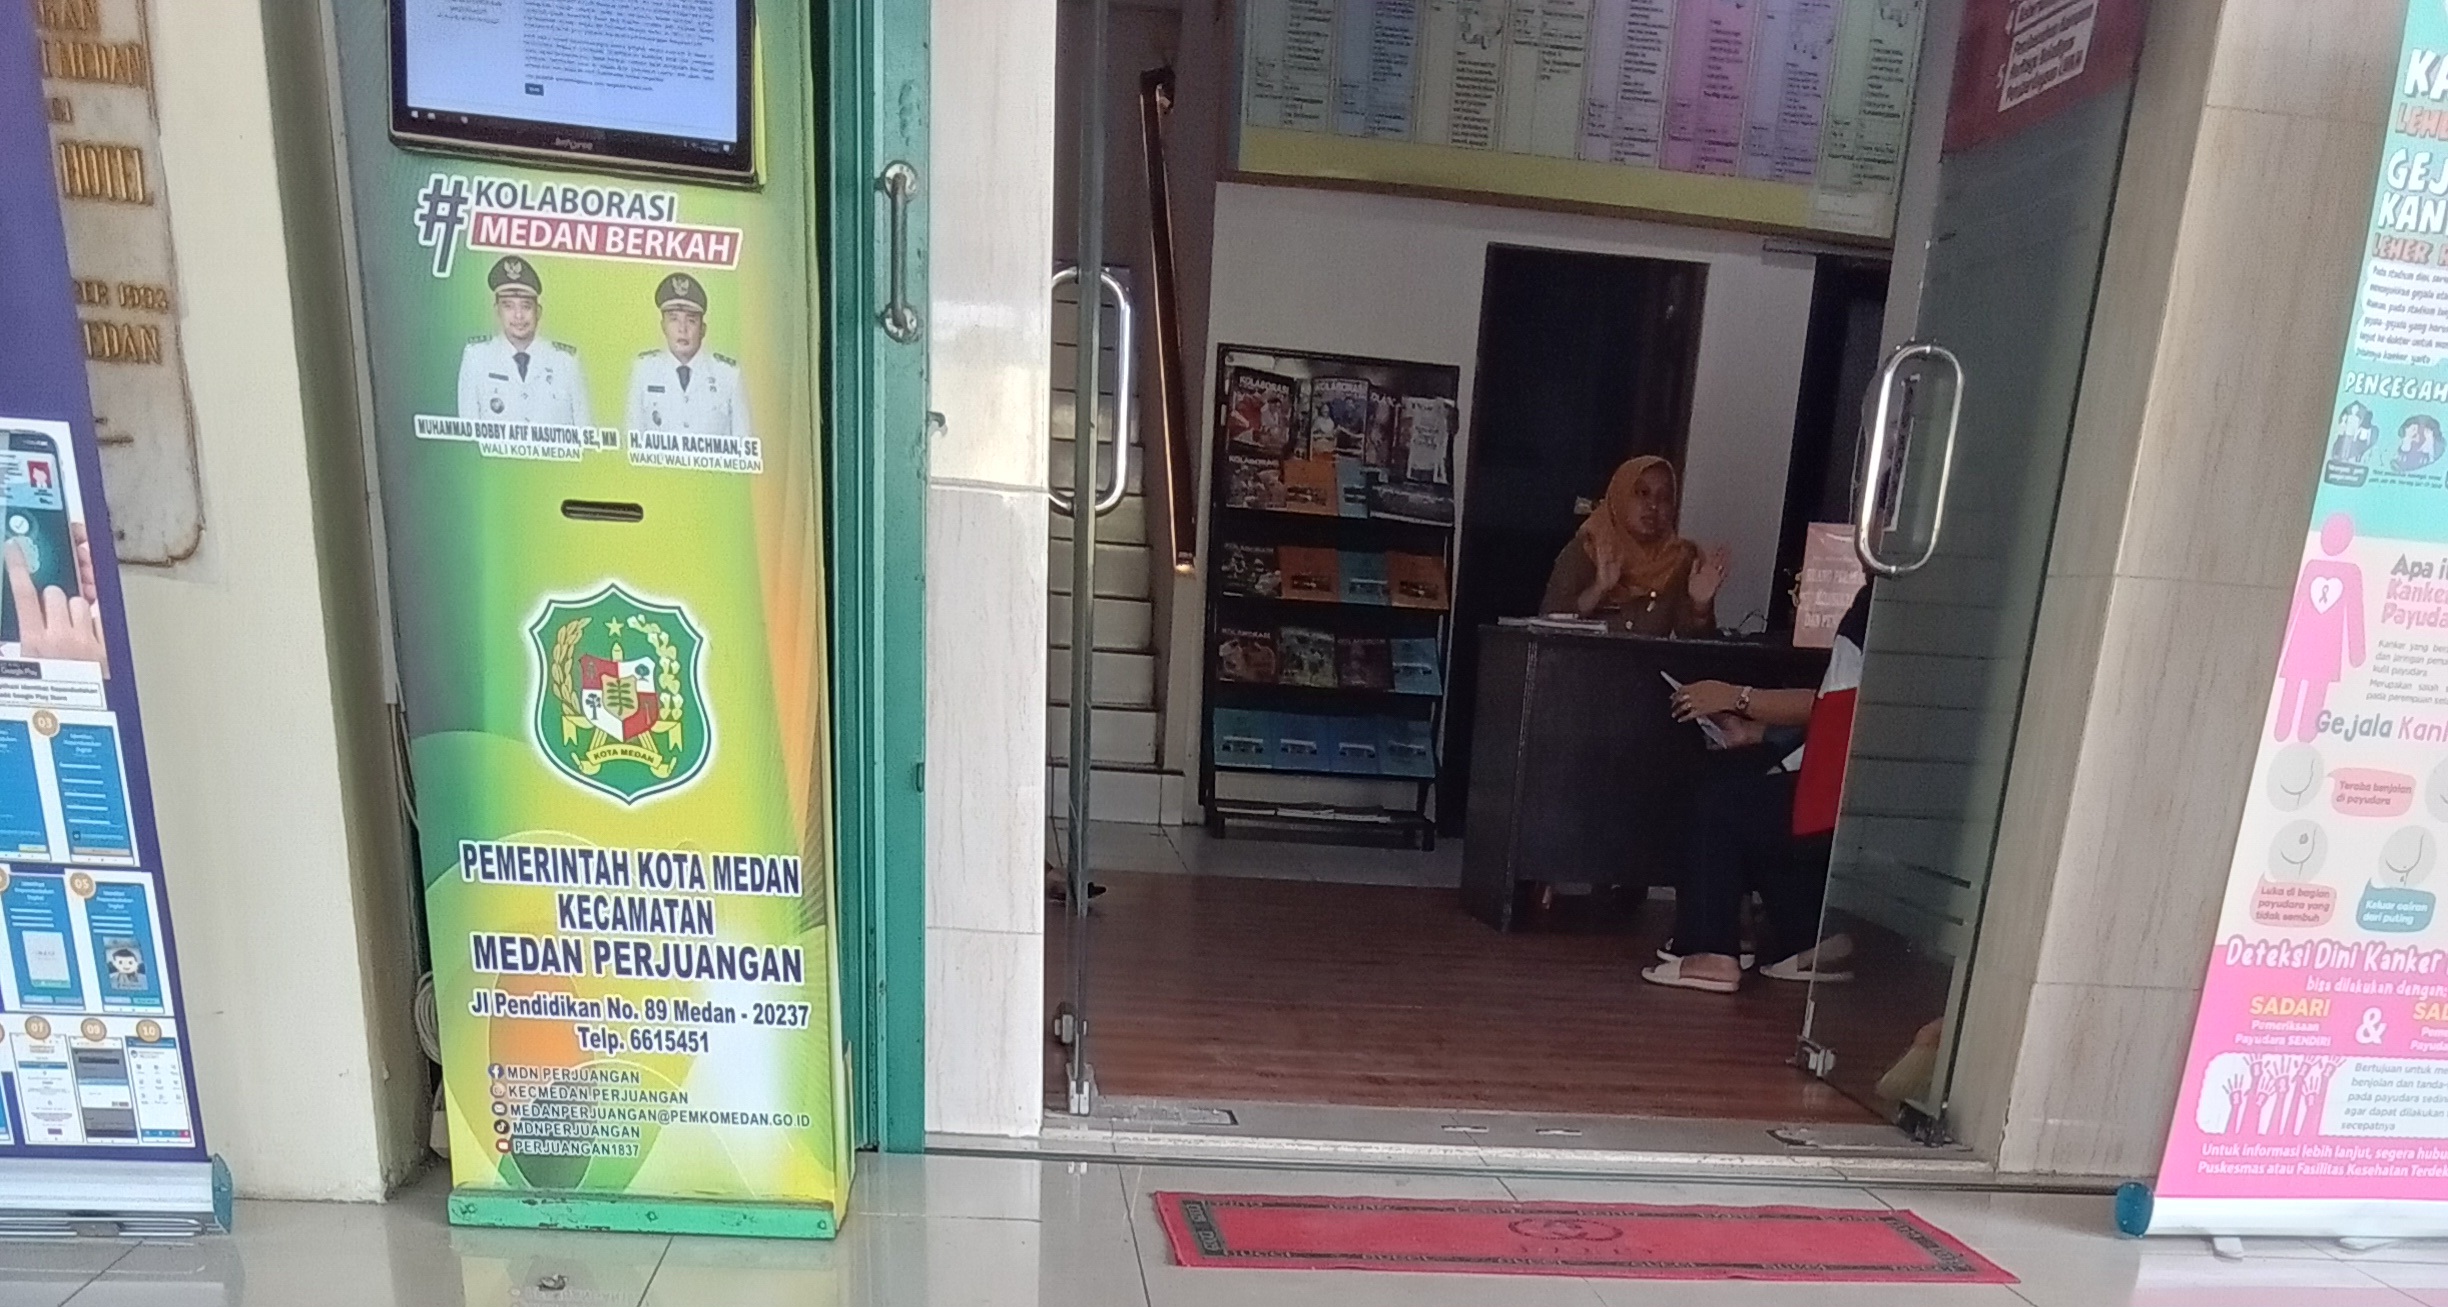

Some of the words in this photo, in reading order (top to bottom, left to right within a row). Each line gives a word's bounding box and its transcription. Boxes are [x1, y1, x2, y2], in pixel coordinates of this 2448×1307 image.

[59, 140, 152, 206] HOTEL
[475, 180, 676, 222] KOLABORASI
[2378, 191, 2448, 235] KAN
[480, 217, 598, 253] MEDAN
[605, 228, 731, 263] BERKAH
[2372, 232, 2433, 265] LEHER
[82, 320, 162, 364] EDAN
[418, 418, 472, 438] MUHAMMAD
[475, 422, 507, 440] BOBBY
[509, 425, 529, 441] AFIF
[531, 426, 581, 445] NASUTION,
[602, 431, 617, 446] MM
[482, 443, 507, 454] WALI
[511, 445, 539, 457] KOTA
[541, 446, 580, 459] MEDAN
[630, 432, 642, 448] H.
[645, 433, 679, 451] AULIA
[682, 436, 742, 456] RACHMAN,
[744, 440, 759, 456] SE
[630, 453, 659, 464] WAKIL
[665, 454, 690, 466] WALI
[692, 456, 720, 468] KOTA
[723, 458, 761, 471] MEDAN
[2390, 553, 2434, 582] Apa
[2409, 643, 2429, 653] yang
[2365, 692, 2387, 701] pada
[2316, 709, 2394, 742] Gejala
[593, 748, 618, 760] KOTA
[620, 748, 655, 763] MEDAN
[2340, 780, 2371, 791] Teraba
[2373, 783, 2412, 795] benjolan
[2336, 793, 2346, 802] di
[2346, 795, 2391, 805] payudara
[463, 844, 630, 886] PEMERINTAH
[638, 851, 706, 890] KOTA
[713, 855, 800, 894] MEDAN
[74, 878, 89, 889] 05
[2261, 886, 2284, 897] Luka
[2286, 887, 2296, 897] di
[2299, 887, 2330, 900] bagian
[2257, 900, 2305, 911] payudara
[2307, 902, 2331, 913] yang
[2365, 899, 2395, 911] Keluar
[559, 893, 714, 935] KECAMATAN
[2255, 911, 2280, 921] tidak
[2282, 912, 2320, 923] sembuh
[2362, 912, 2382, 923] dari
[2383, 913, 2415, 926] puting
[473, 935, 583, 974] MEDAN
[593, 941, 803, 983] PERJUANGAN
[2226, 936, 2313, 969] Deteksi
[2314, 940, 2359, 970] Dini
[2364, 943, 2443, 975] Kanker
[2306, 974, 2332, 993] bisa
[2333, 976, 2394, 996] dilakukan
[496, 993, 601, 1019] Pendidikan
[608, 998, 639, 1020] No.
[645, 999, 668, 1022] 89
[675, 1001, 736, 1024] Medan
[754, 1003, 810, 1027] 20237
[2249, 996, 2331, 1017] SADARI
[2356, 1006, 2387, 1045] &
[2250, 1019, 2320, 1033] Pemeriksaan
[142, 1026, 156, 1035] 10
[577, 1026, 625, 1053] Telp.
[631, 1029, 710, 1053] 6615451
[2234, 1033, 2286, 1047] Payudara
[2287, 1035, 2332, 1047] SENDIRI
[508, 1067, 539, 1080] MDN
[543, 1068, 640, 1084] PERJUANGAN
[2354, 1062, 2403, 1074] Bertujuan
[2405, 1064, 2431, 1074] untuk
[2351, 1077, 2394, 1088] benjolan
[2396, 1079, 2414, 1088] dan
[2347, 1092, 2373, 1102] pada
[2374, 1093, 2420, 1103] payudara
[2344, 1107, 2367, 1117] agar
[2368, 1107, 2397, 1117] dapat
[2399, 1108, 2445, 1118] dilakukan
[513, 1122, 641, 1139] MDNPERJUANGAN
[2341, 1122, 2396, 1132] secepatnya
[515, 1140, 640, 1157] PERJUANGAN1837
[2202, 1143, 2240, 1157] Untuk
[2242, 1144, 2300, 1158] informasi
[2302, 1145, 2333, 1158] lebih
[2374, 1148, 2415, 1163] segera
[2197, 1161, 2265, 1175] Puskesmas
[2266, 1163, 2294, 1175] atau
[2296, 1163, 2345, 1176] Fasilitas
[2346, 1164, 2408, 1177] Kesehatan
